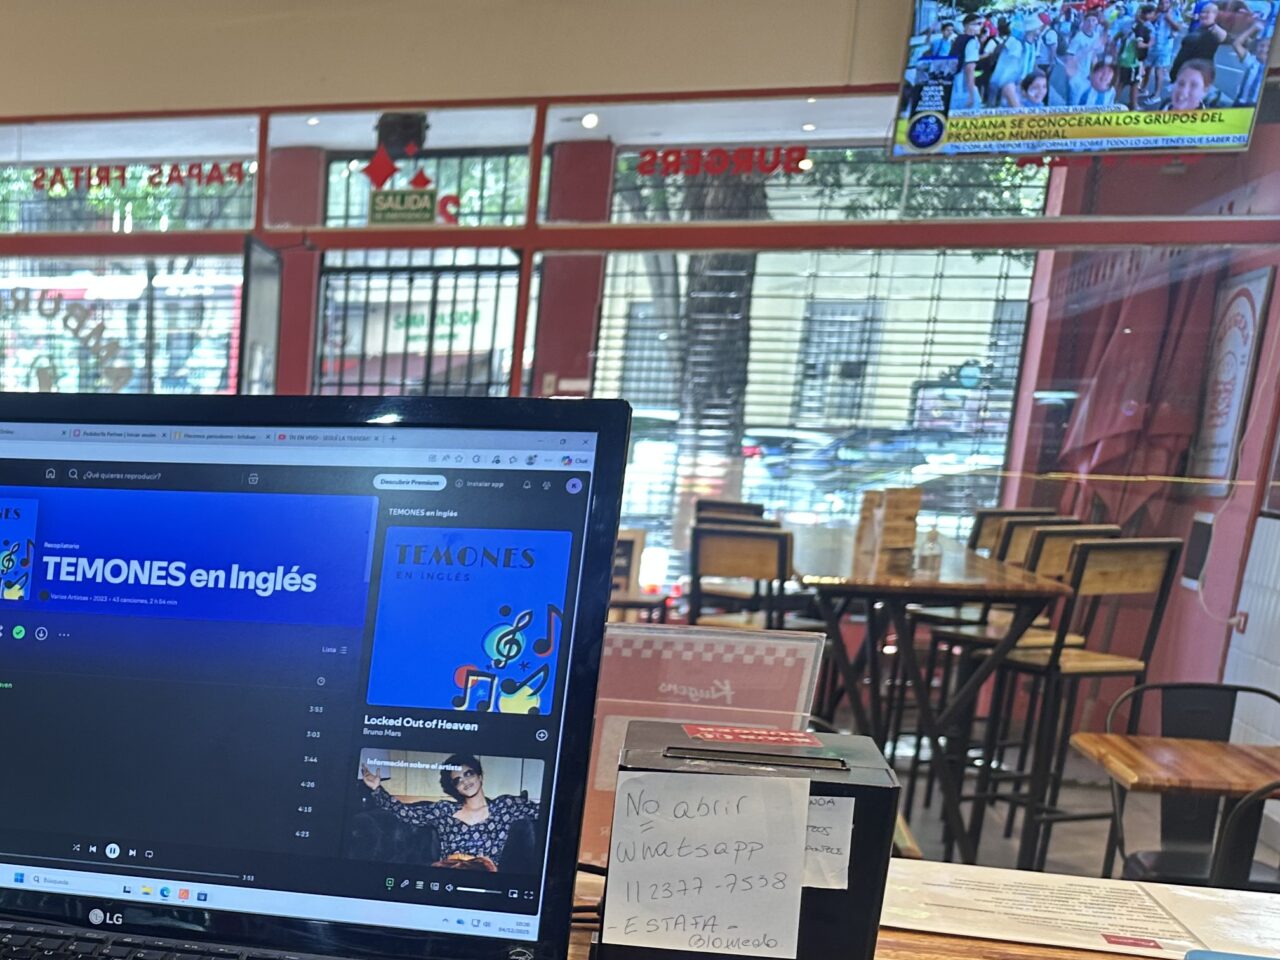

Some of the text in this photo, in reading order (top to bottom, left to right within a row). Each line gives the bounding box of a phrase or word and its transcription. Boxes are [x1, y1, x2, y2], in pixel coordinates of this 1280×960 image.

[1010, 119, 1024, 129] SE
[1115, 115, 1140, 125] LOS
[1144, 113, 1197, 124] GRUPOS
[1201, 113, 1224, 122] DEL
[1008, 130, 1067, 140] MUNDIAL
[375, 195, 431, 210] SALIDA
[388, 508, 425, 517] TEMONES
[395, 544, 536, 570] TEMONES
[42, 555, 317, 597] TEMONES en Inglés
[396, 570, 471, 582] EN INGLÉS
[364, 714, 478, 732] Locked Out of Heaven
[363, 727, 401, 738] Bruno Mars
[409, 760, 426, 769] sobre
[626, 790, 749, 820] No abrir
[106, 913, 123, 925] LG
